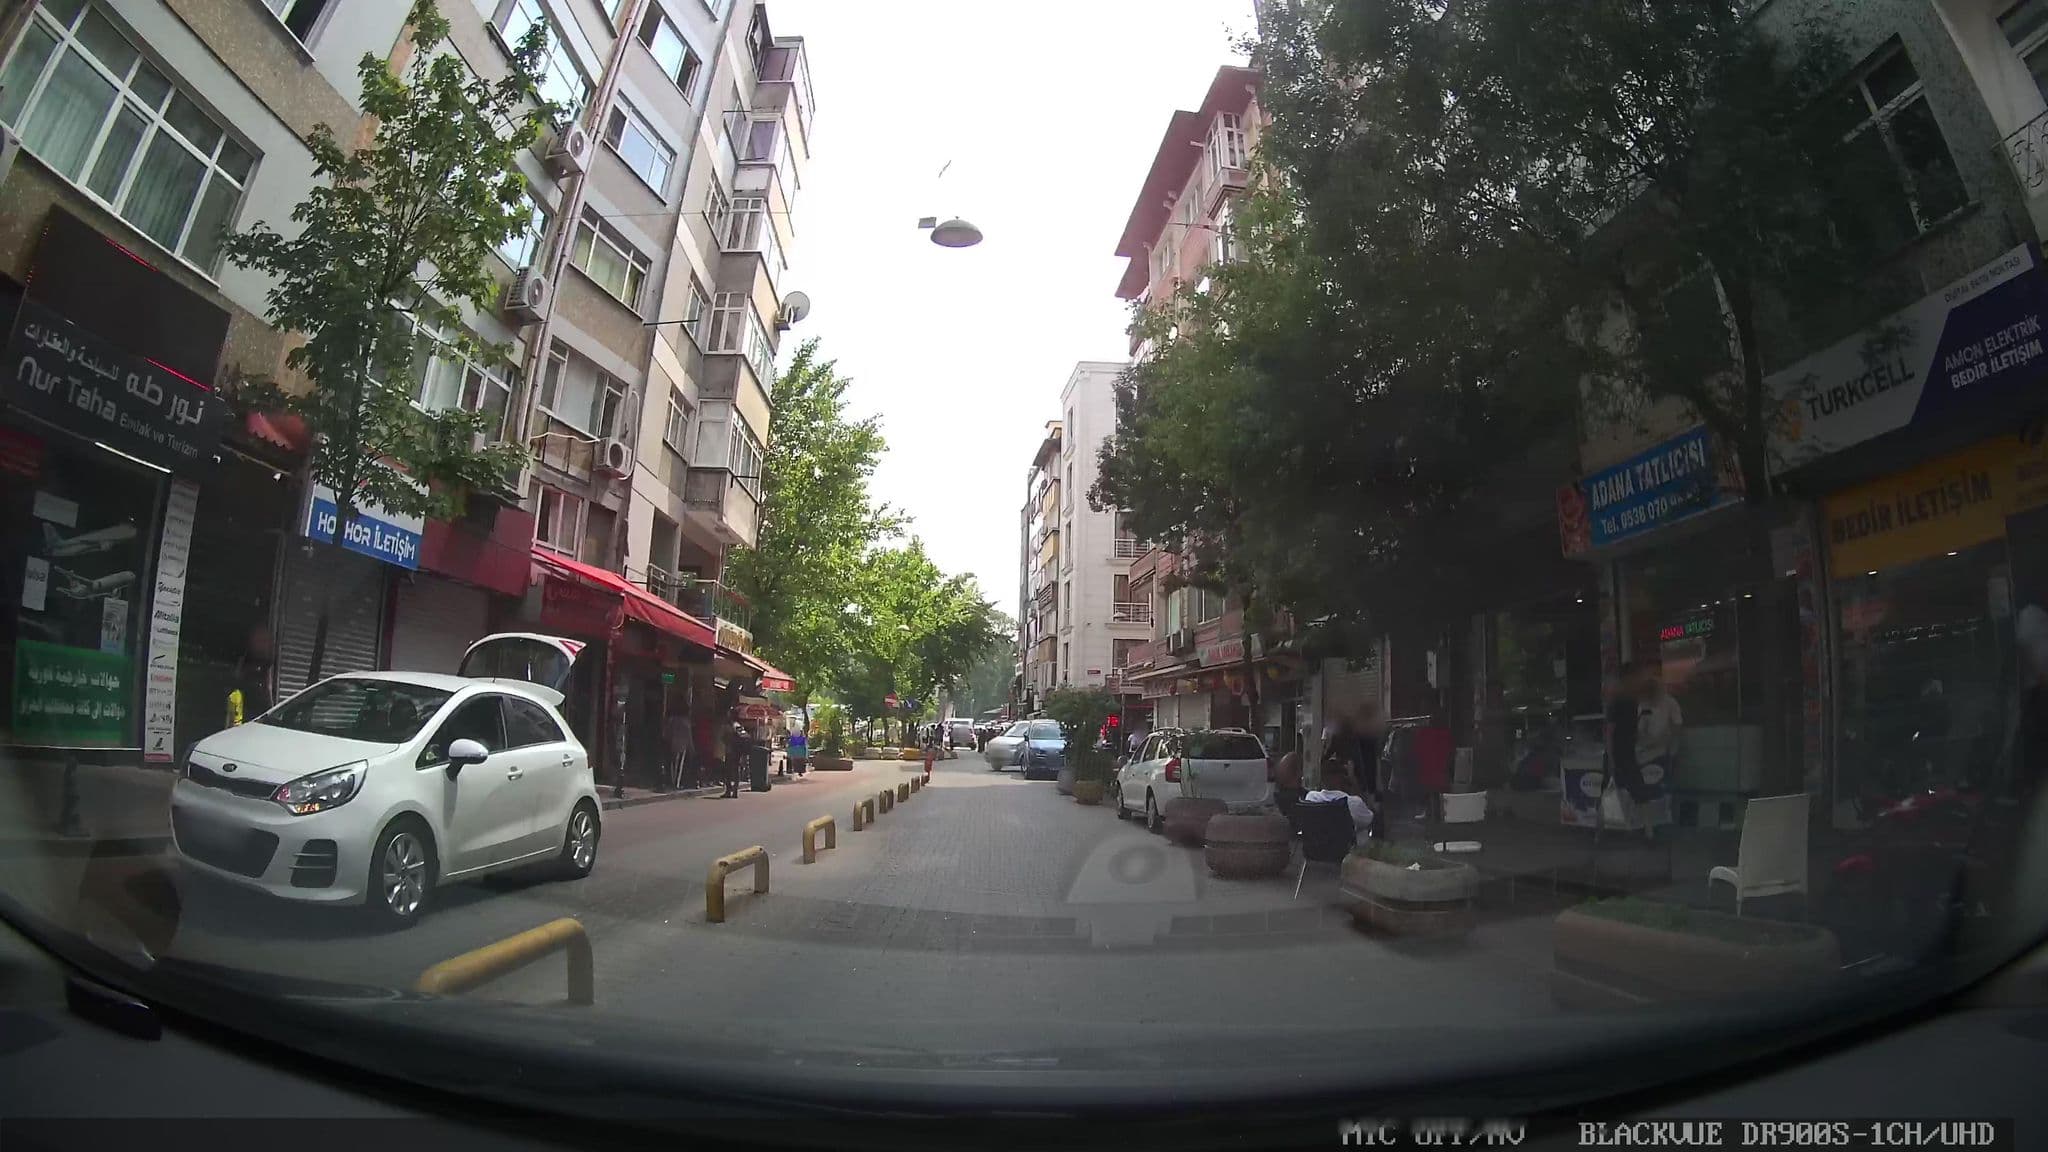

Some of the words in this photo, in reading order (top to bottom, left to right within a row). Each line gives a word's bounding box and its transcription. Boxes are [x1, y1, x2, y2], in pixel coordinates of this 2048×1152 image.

[1944, 342, 1984, 372] AMON
[1984, 313, 2042, 354] ELEKTRİK
[1951, 360, 1989, 390] BEDİR
[1988, 338, 2044, 375] İLETİŞİM
[17, 355, 62, 394] Nur
[68, 375, 117, 423] Taha
[119, 412, 151, 438] Emlak
[153, 430, 165, 443] ve
[167, 432, 200, 459] Turizm
[126, 373, 163, 405] طه
[165, 394, 205, 425] نور
[1806, 356, 1915, 422] TURKCELL
[1592, 467, 1635, 511] ADANA
[1636, 437, 1706, 492] TATLICISI
[1601, 516, 1620, 536] Tel.
[1620, 504, 1647, 530] 0538
[1647, 496, 1668, 521] 070
[1831, 495, 1893, 545] BEDİR
[1896, 467, 1993, 528] İLETİŞİM
[373, 524, 416, 562] İLETİŞİM
